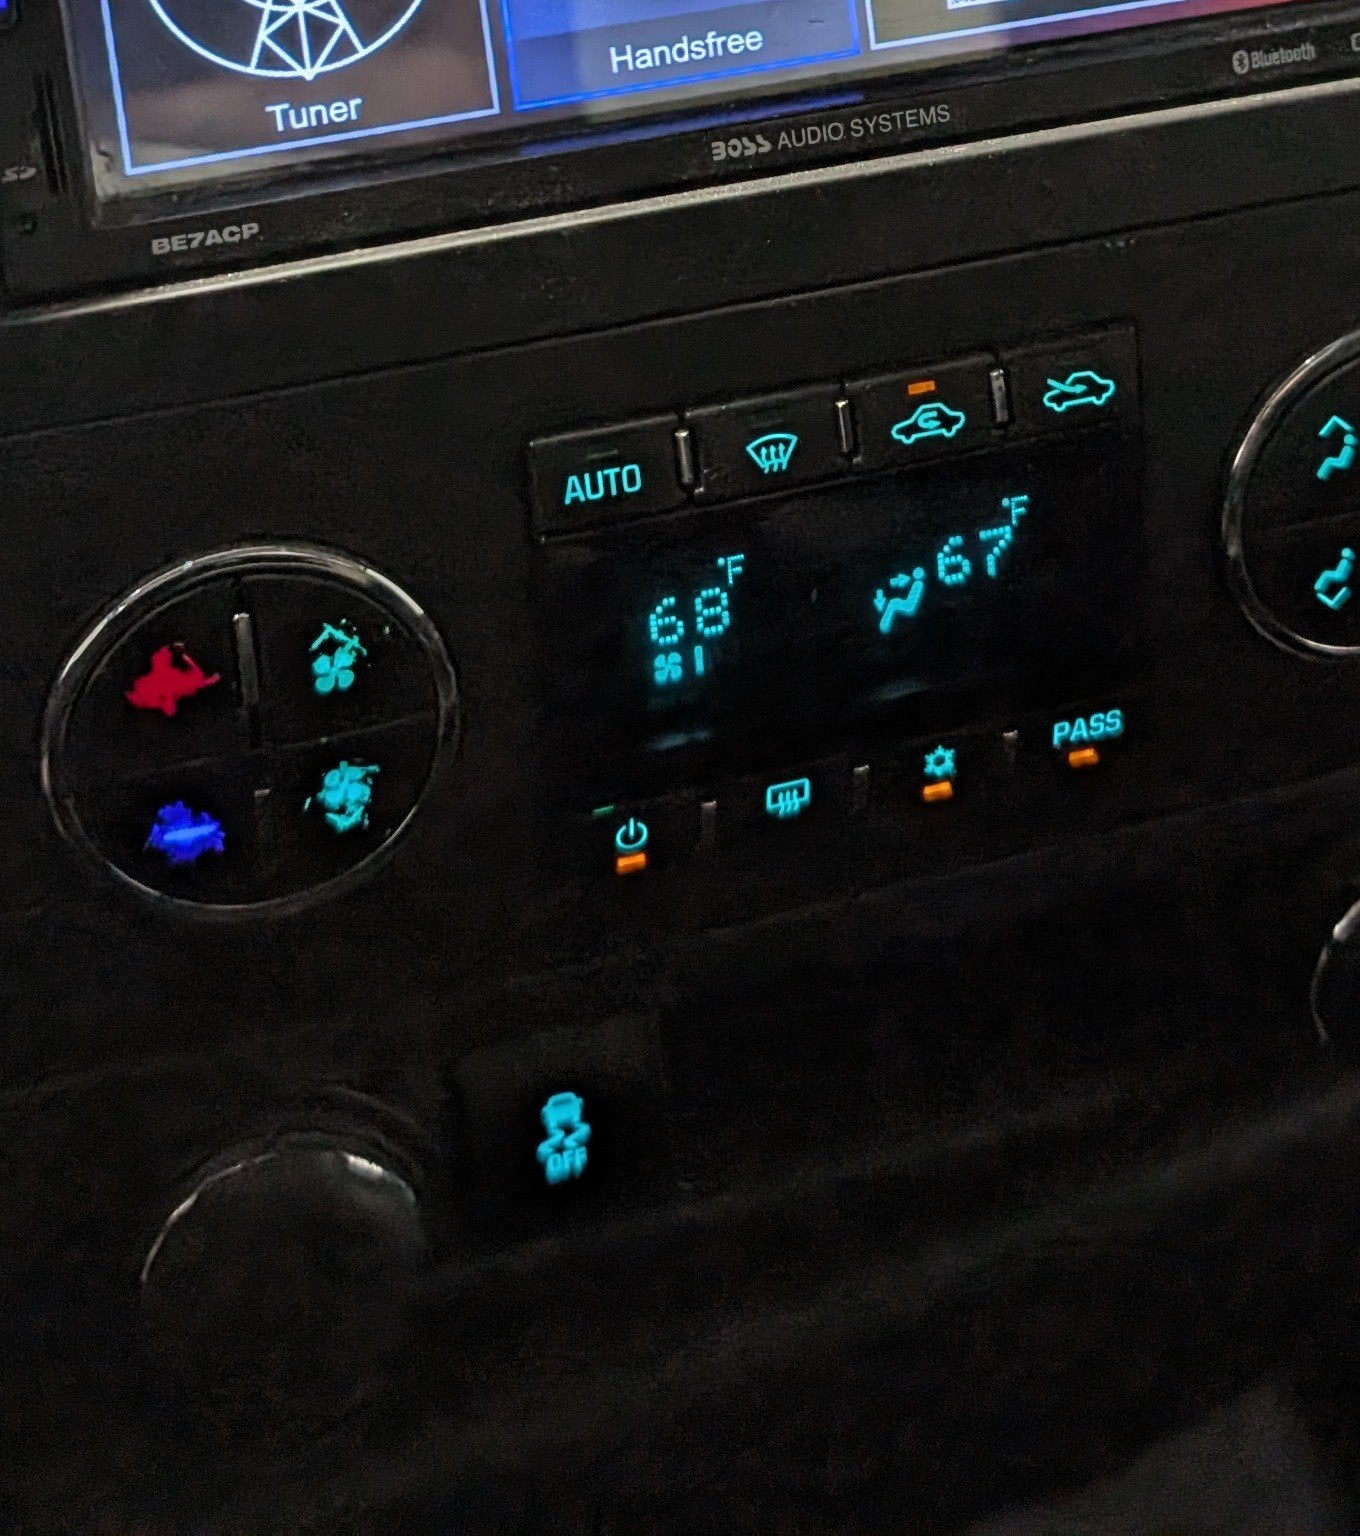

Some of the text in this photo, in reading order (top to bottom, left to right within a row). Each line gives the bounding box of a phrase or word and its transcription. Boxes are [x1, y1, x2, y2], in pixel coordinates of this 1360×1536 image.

[609, 30, 764, 74] Handsfree
[1250, 42, 1316, 68] Bluetooth
[266, 97, 362, 132] Tuner
[712, 105, 951, 161] BOSS AUDIO SYSTEMS
[151, 223, 260, 255] BE7ACP
[564, 464, 642, 505] AUTO
[1053, 710, 1123, 747] PASS
